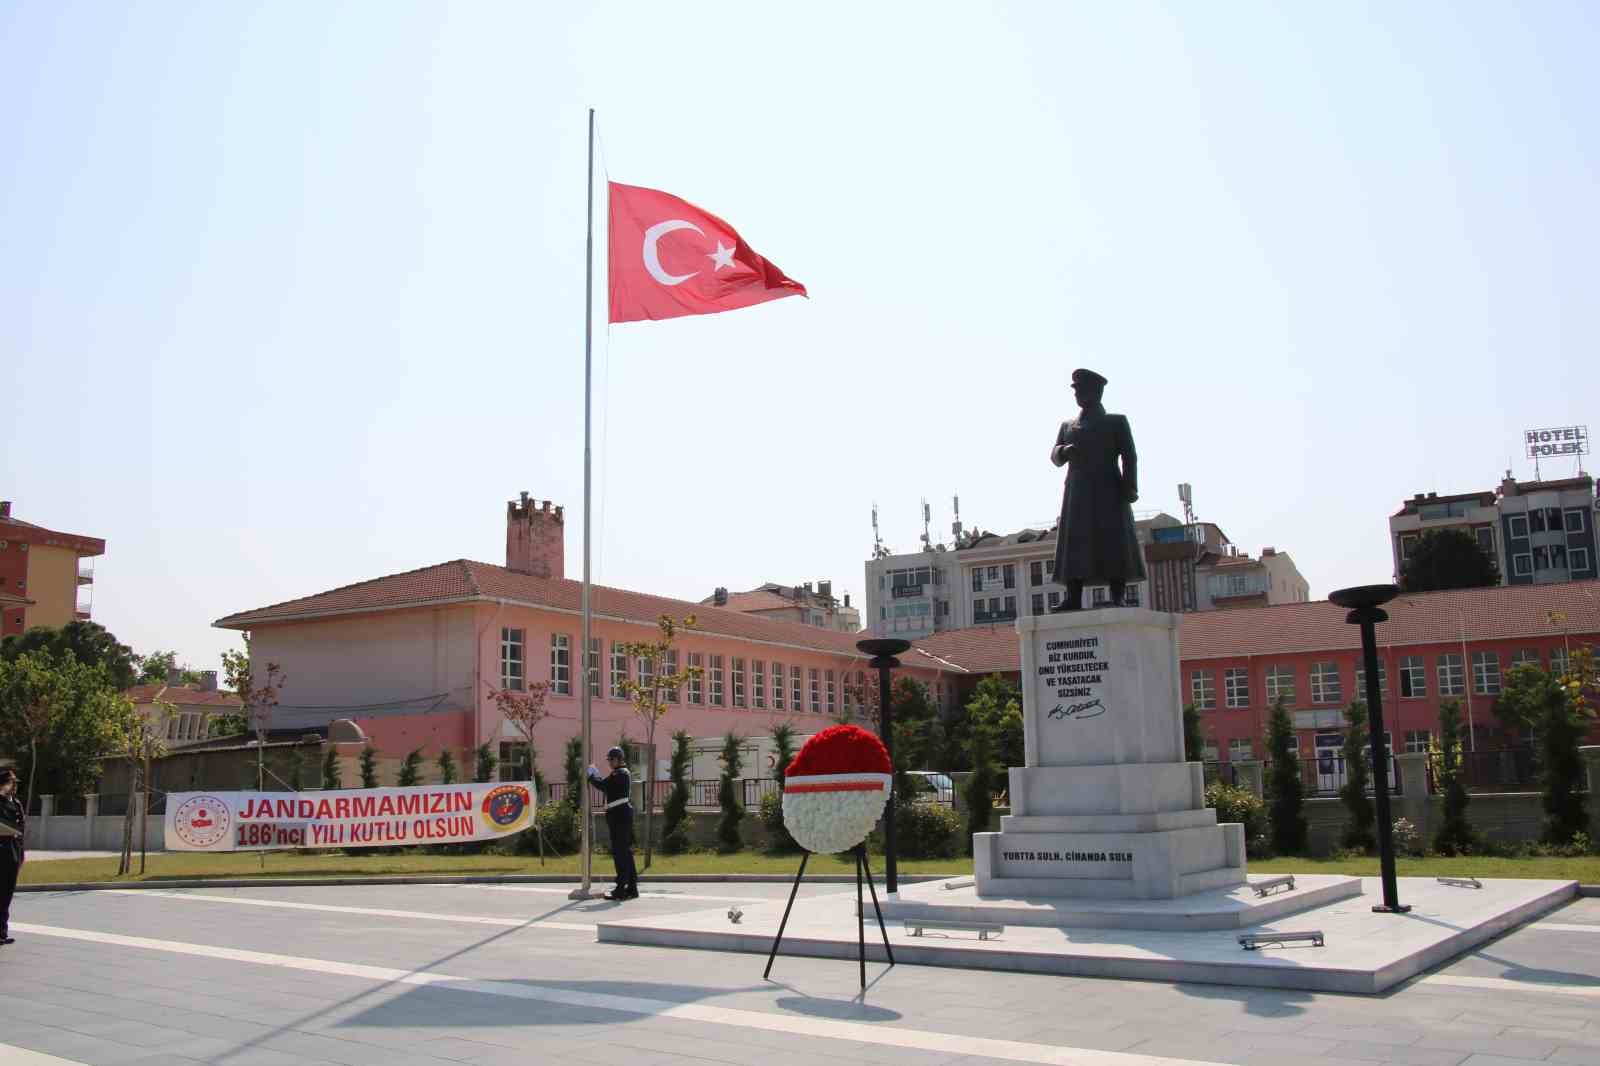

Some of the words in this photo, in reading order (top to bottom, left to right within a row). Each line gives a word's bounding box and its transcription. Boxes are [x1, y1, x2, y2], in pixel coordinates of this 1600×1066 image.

[1527, 428, 1586, 443] HOTEL
[1530, 442, 1584, 456] POLEK
[1039, 666, 1055, 675] ONU
[1057, 662, 1109, 674] YÜKSELTECEK
[1046, 678, 1056, 687] VE
[239, 792, 473, 819] JANDARMAMIZIN
[312, 823, 344, 844] YILI
[350, 820, 406, 842] KUTLU
[413, 816, 474, 838] OLSUN
[1003, 852, 1035, 861] YURTTA
